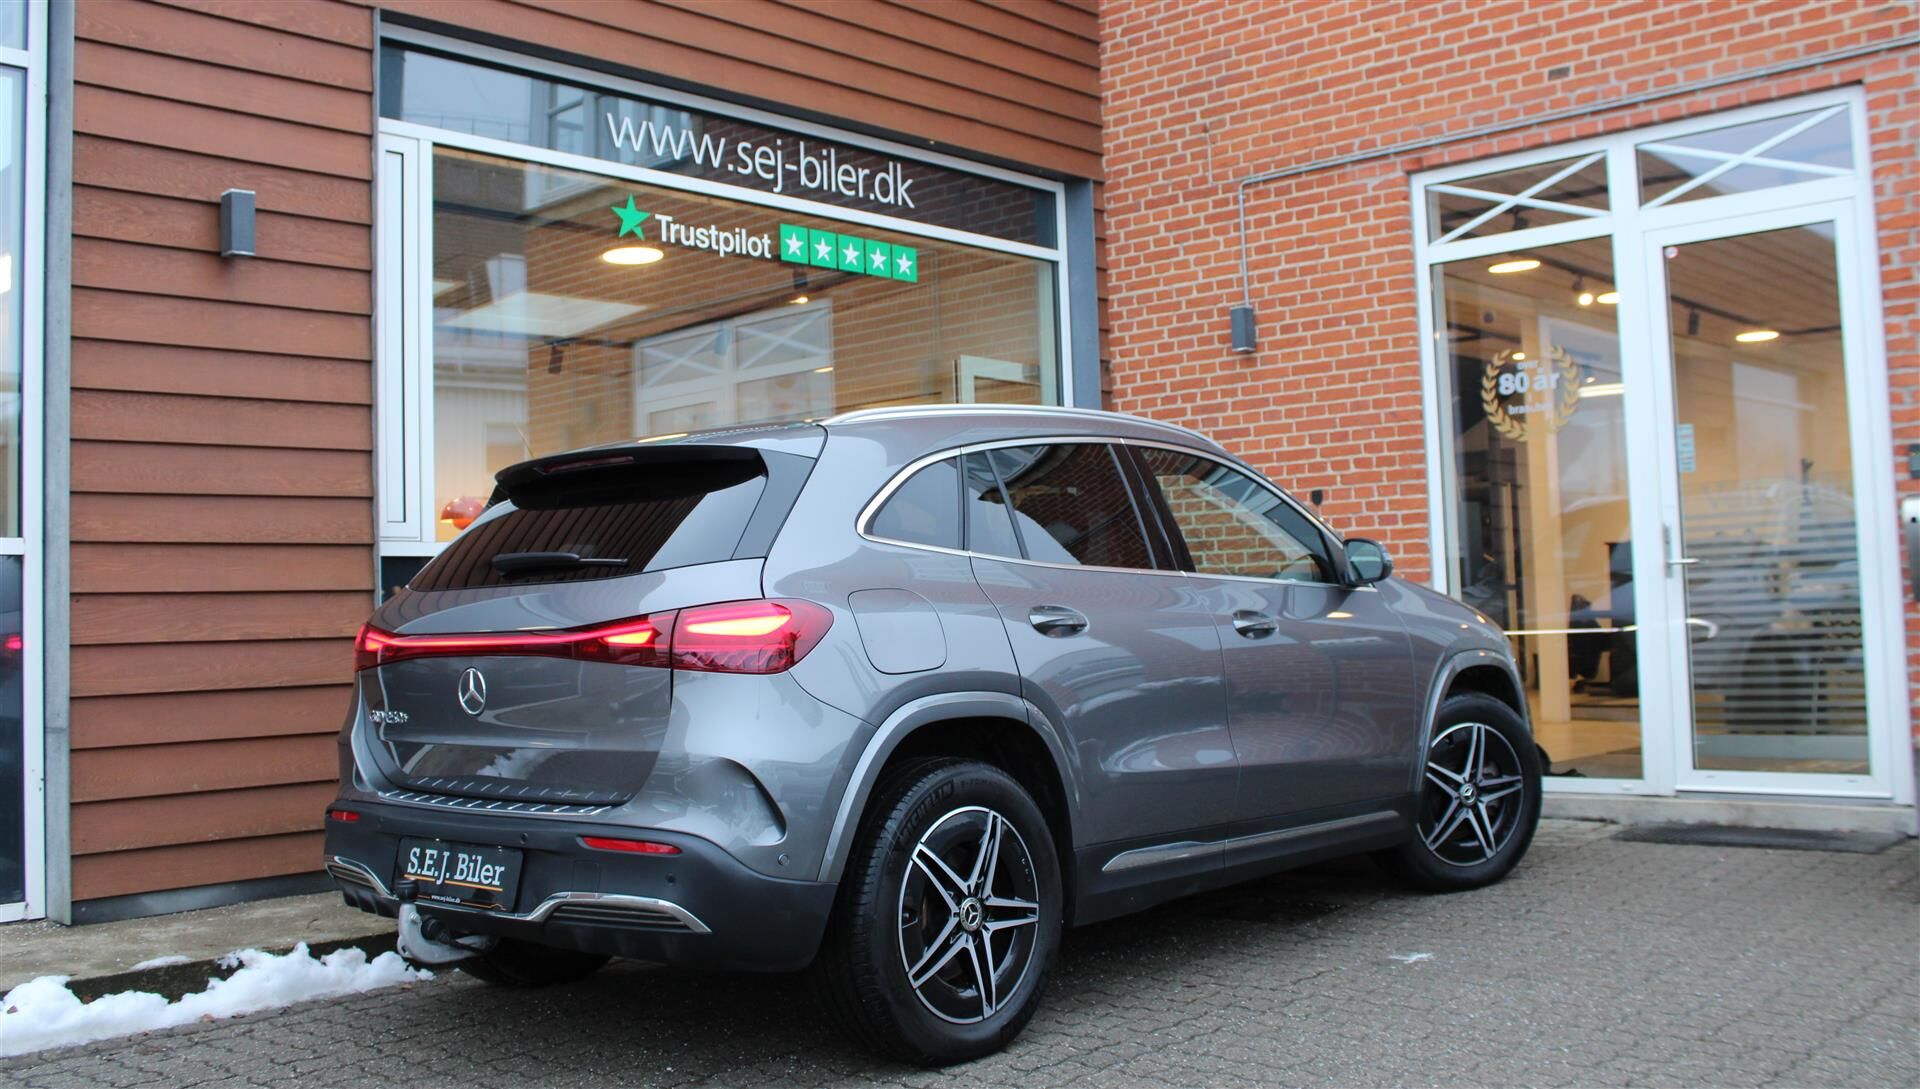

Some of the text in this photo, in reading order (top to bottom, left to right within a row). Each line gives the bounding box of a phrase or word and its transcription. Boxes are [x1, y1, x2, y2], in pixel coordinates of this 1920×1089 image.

[607, 112, 915, 208] www.sej-biler.dk
[655, 214, 771, 258] Trustpilot
[1499, 367, 1560, 395] 80 år
[407, 847, 505, 886] S.E.J. Biler
